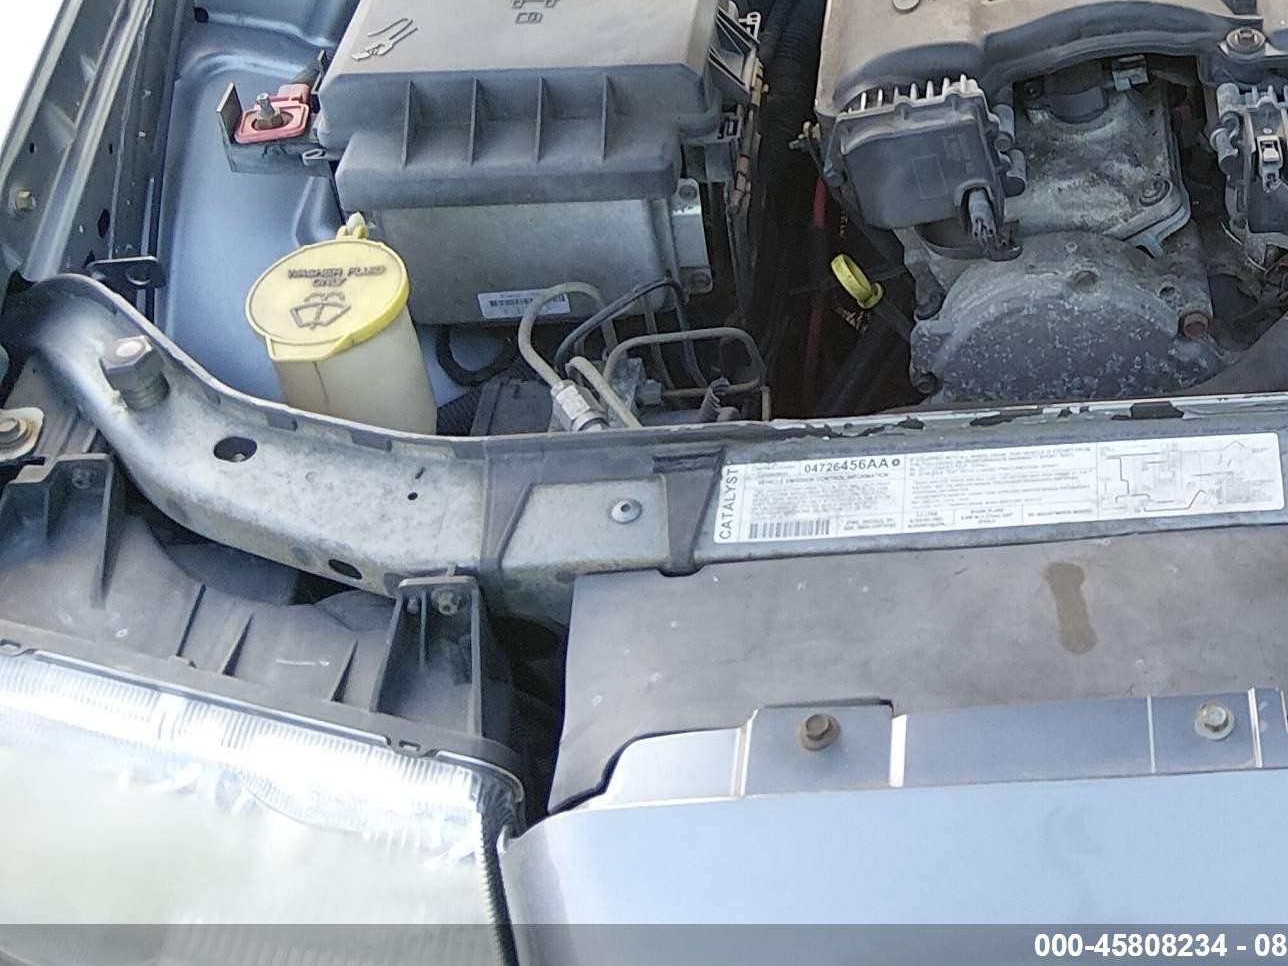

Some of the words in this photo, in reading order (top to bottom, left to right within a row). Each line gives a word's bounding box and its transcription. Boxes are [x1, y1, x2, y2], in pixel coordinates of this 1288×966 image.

[287, 267, 343, 279] WASHER
[347, 265, 386, 277] FLUID
[312, 277, 347, 287] ONLY
[804, 457, 889, 474] 04726456AA
[719, 468, 739, 540] CATALYST
